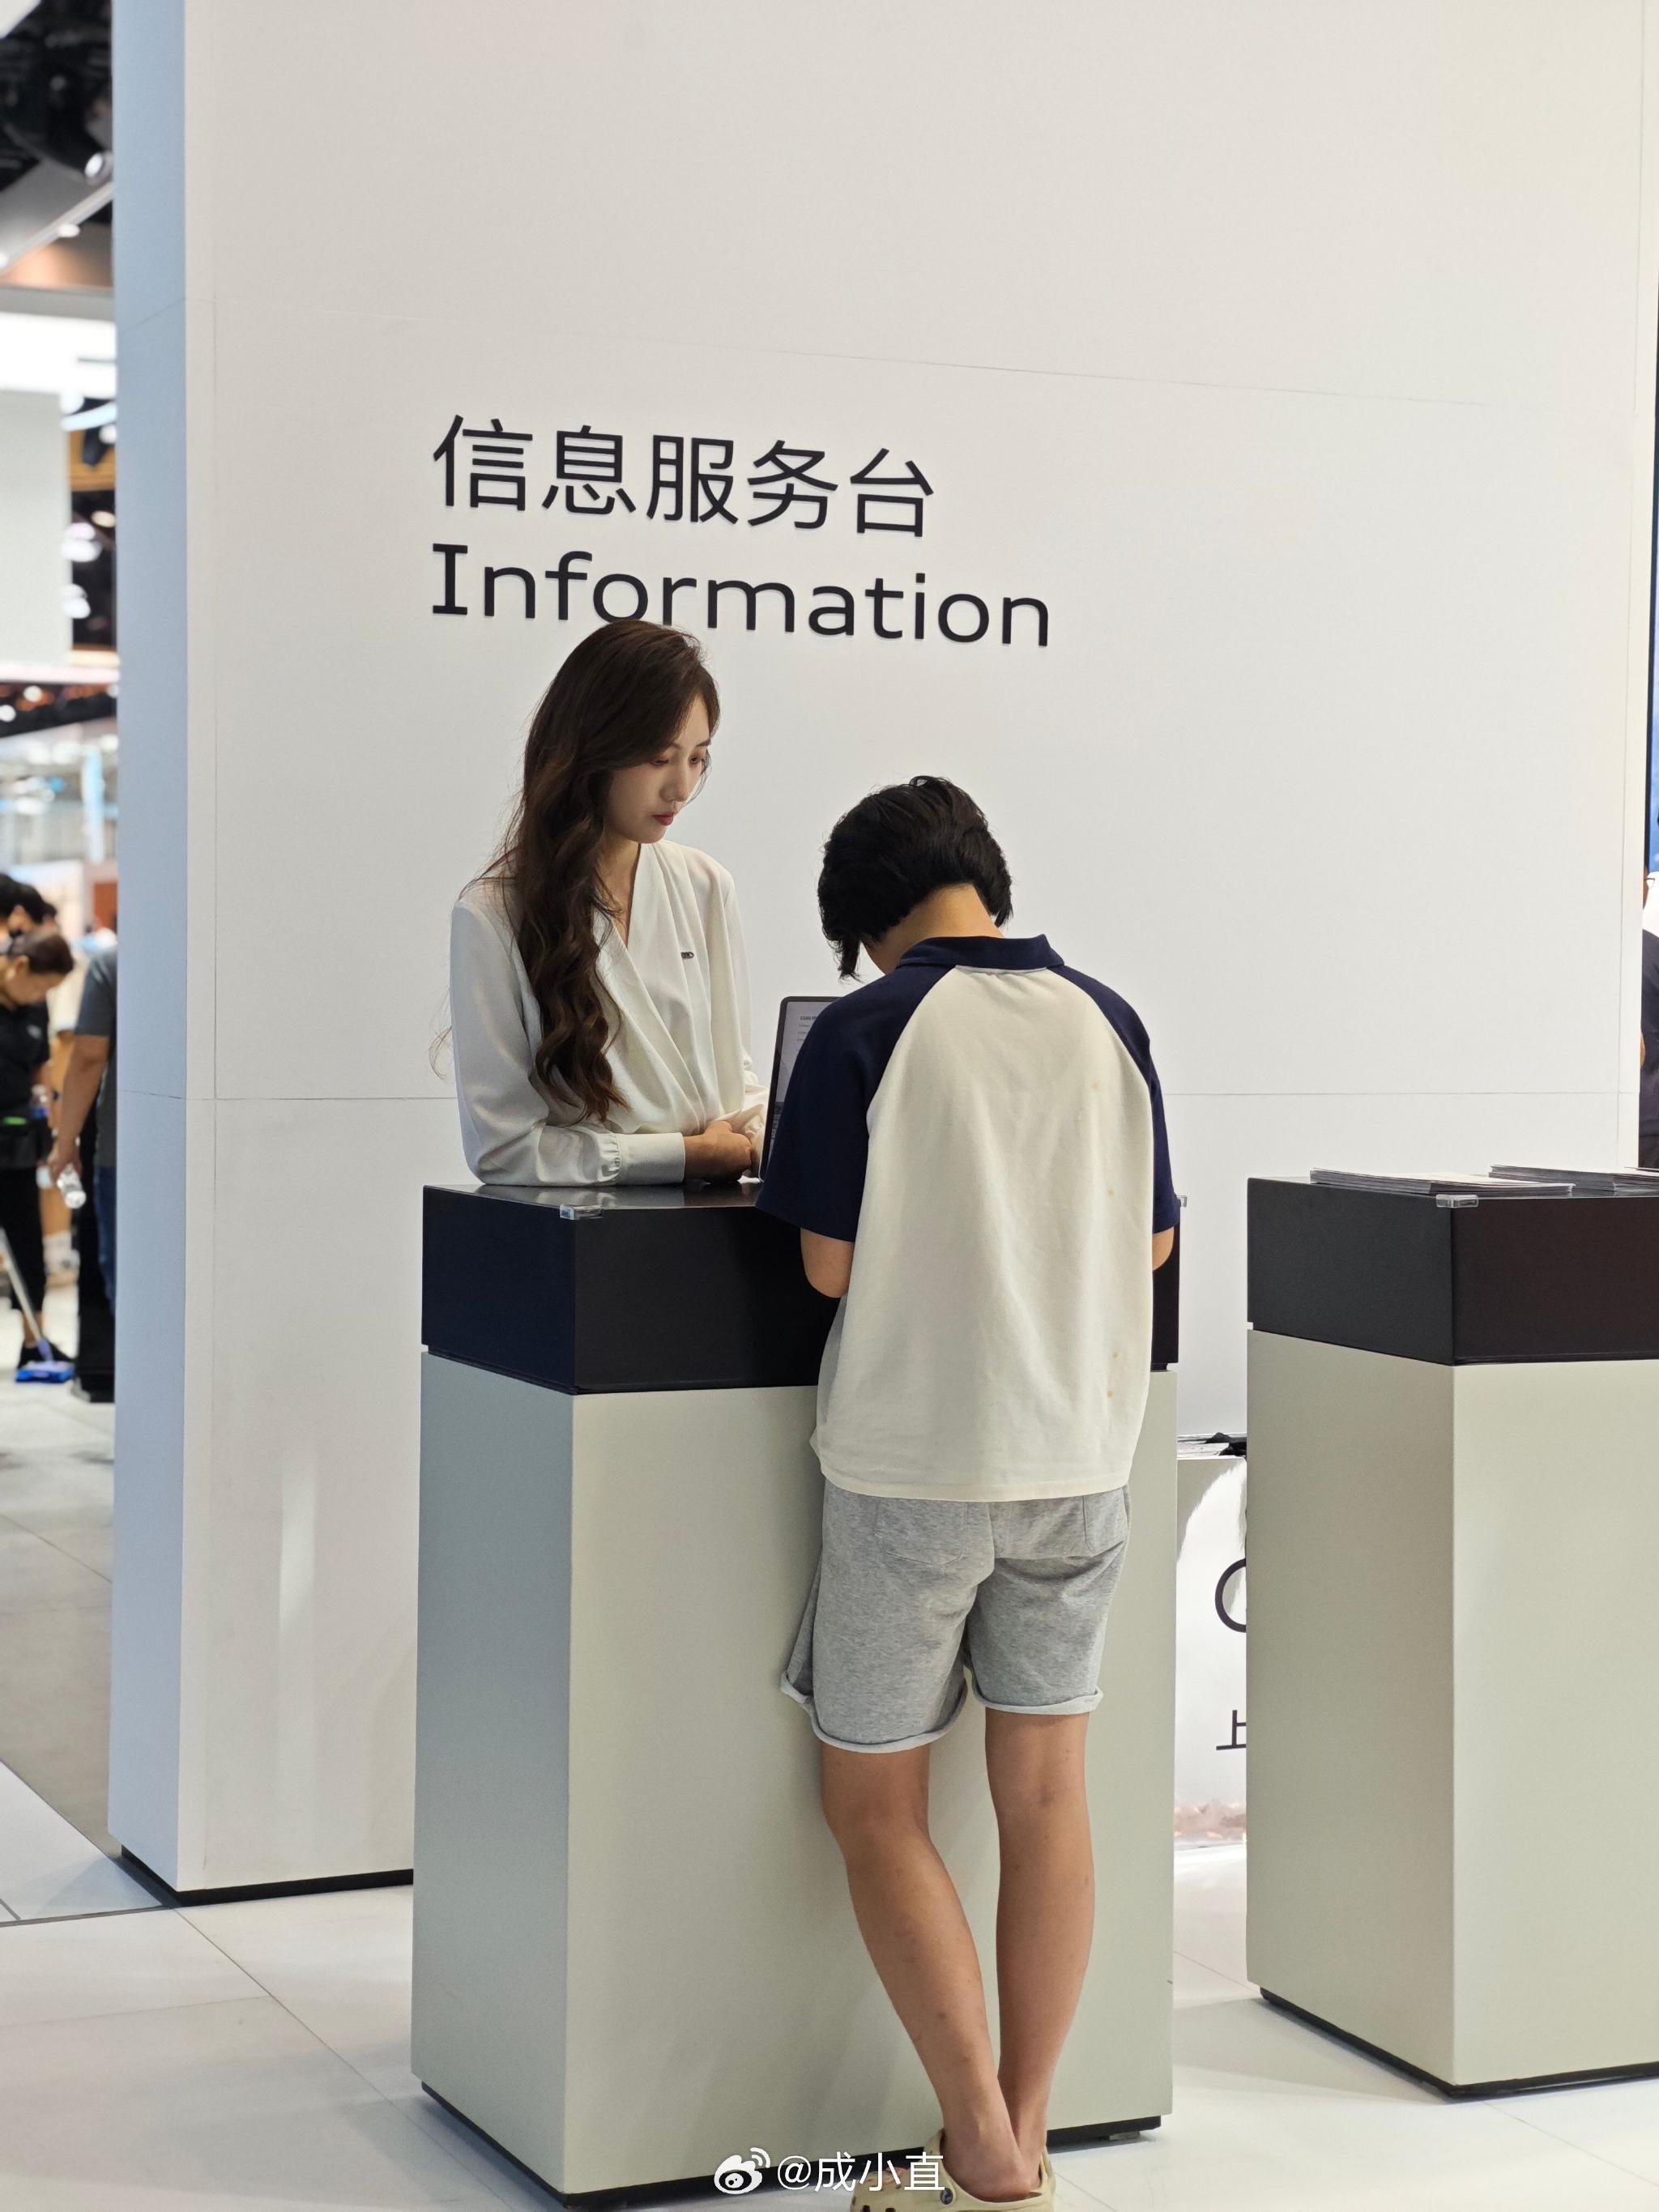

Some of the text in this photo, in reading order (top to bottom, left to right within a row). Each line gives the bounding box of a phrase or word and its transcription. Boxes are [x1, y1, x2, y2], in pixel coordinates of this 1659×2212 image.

[433, 414, 934, 538] 信息服务台
[433, 543, 1049, 647] Information
